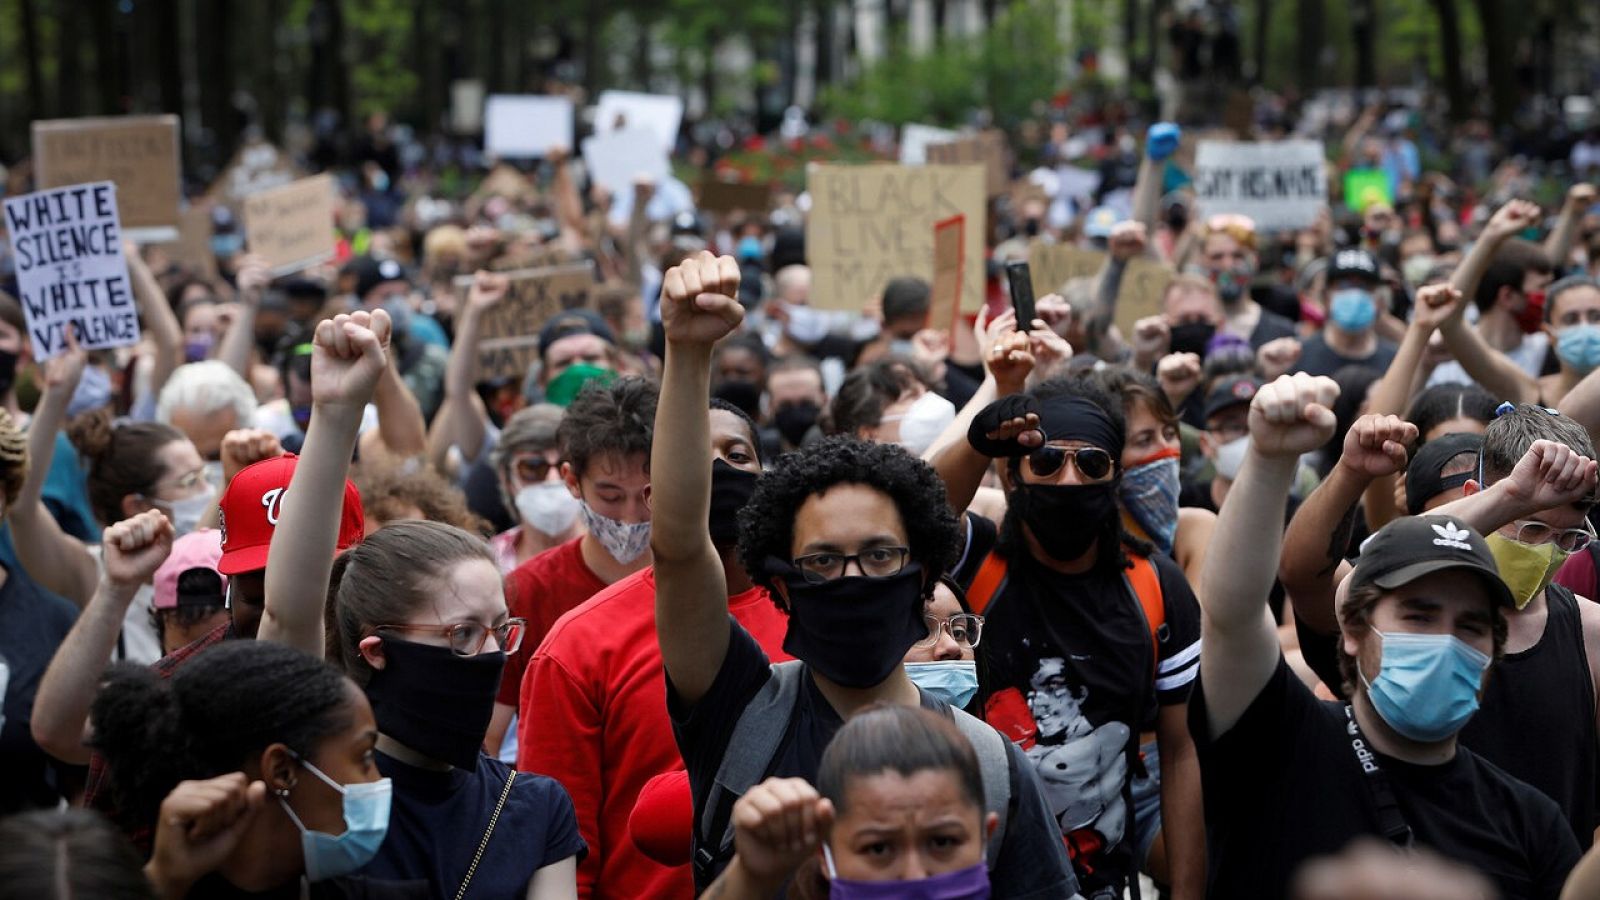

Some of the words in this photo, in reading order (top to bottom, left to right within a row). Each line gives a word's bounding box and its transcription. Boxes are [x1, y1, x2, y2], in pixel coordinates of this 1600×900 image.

[6, 186, 113, 233] WHITE
[826, 171, 960, 217] BLACK
[16, 222, 119, 272] SILENCE
[55, 261, 83, 280] IS
[23, 276, 128, 321] WHITE
[34, 314, 135, 353] VIOLENCE
[1433, 538, 1472, 551] adidas
